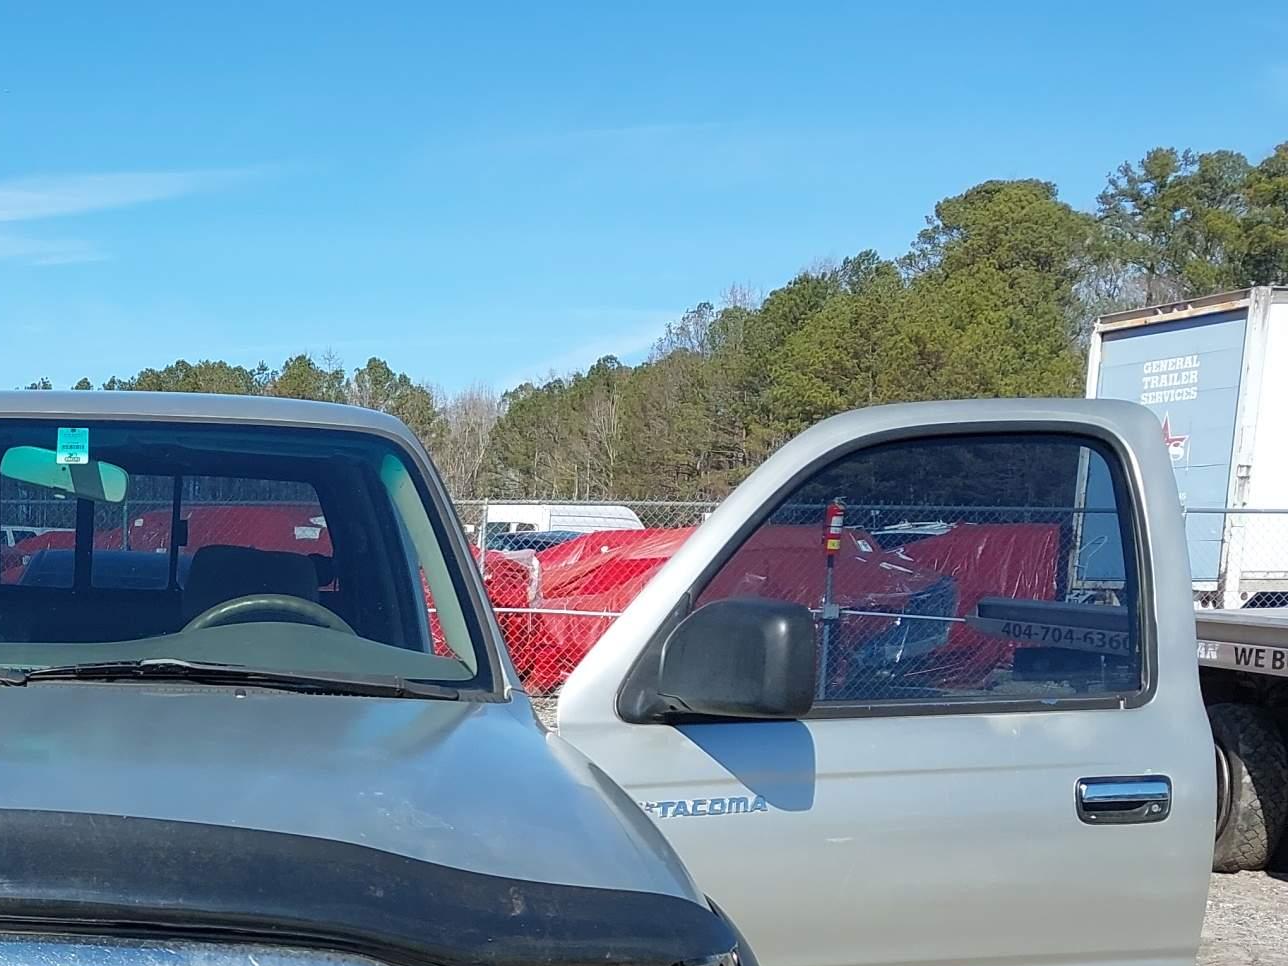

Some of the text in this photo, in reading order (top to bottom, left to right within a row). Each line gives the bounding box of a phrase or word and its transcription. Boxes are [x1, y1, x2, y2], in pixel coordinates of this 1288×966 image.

[1143, 354, 1200, 374] GENERAL
[1142, 370, 1199, 389] TRAILER
[1140, 386, 1198, 405] SERVICES
[1234, 646, 1266, 668] WE
[1272, 650, 1288, 671] B
[655, 794, 768, 817] TACOMA
